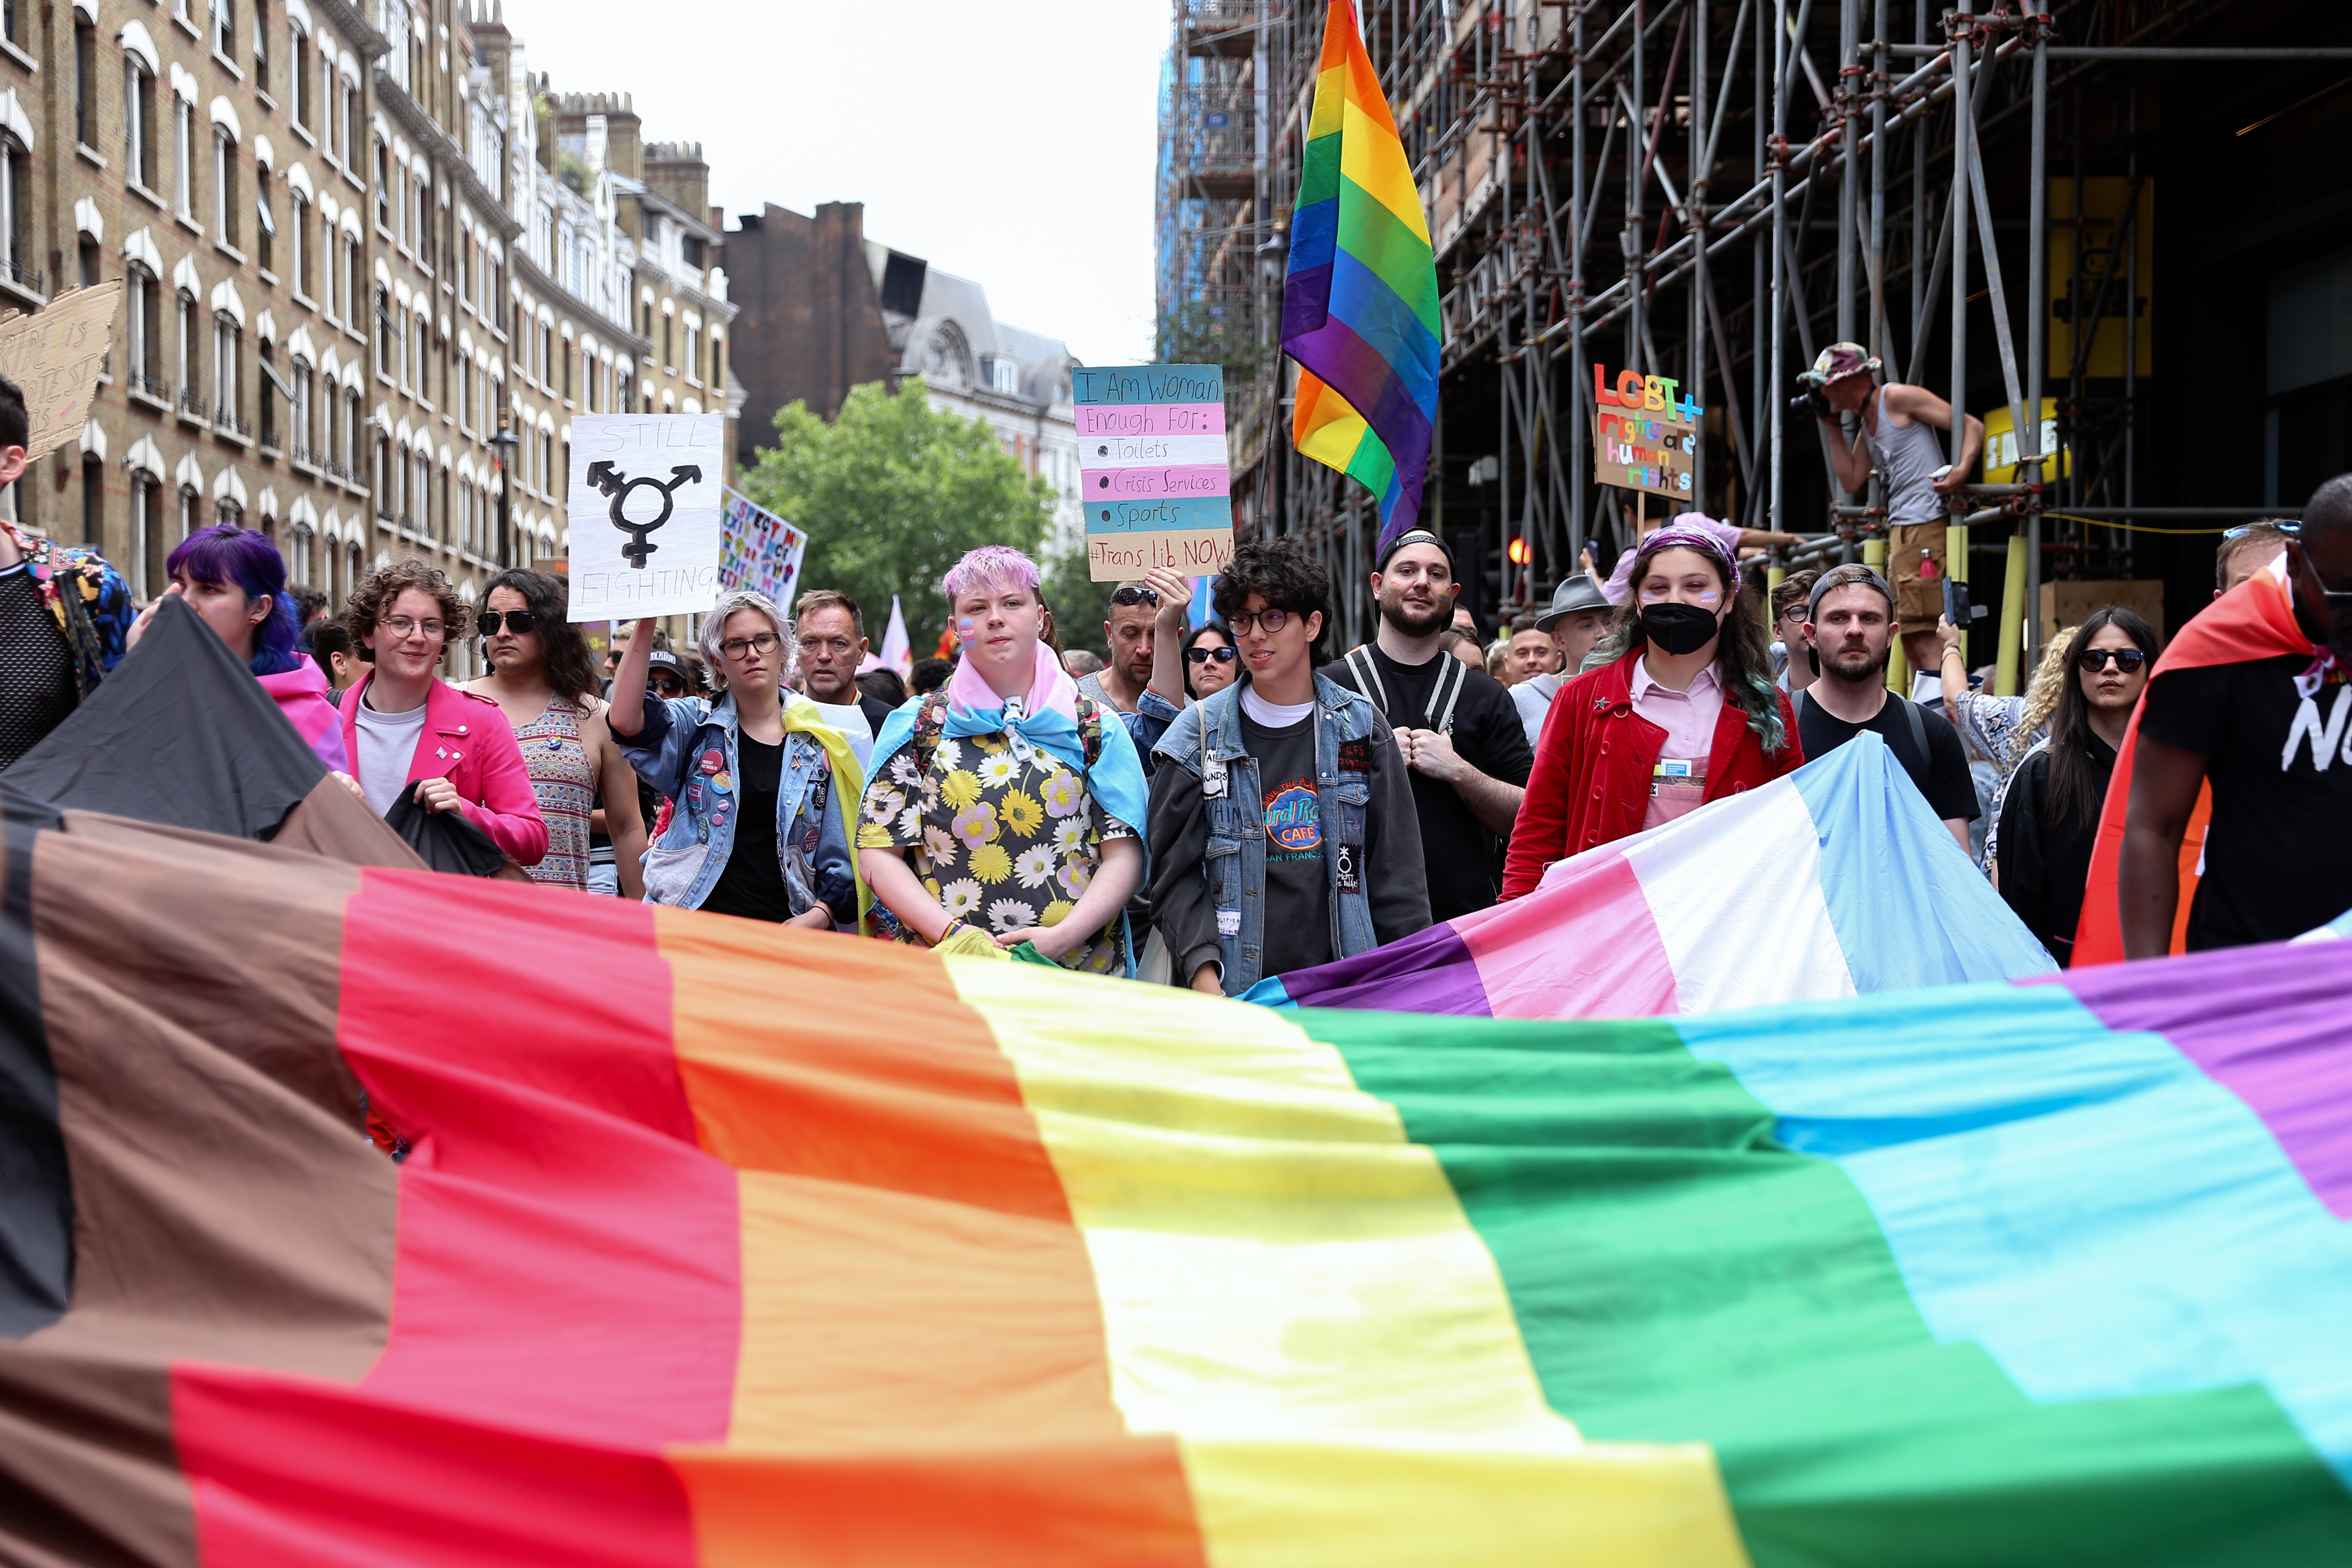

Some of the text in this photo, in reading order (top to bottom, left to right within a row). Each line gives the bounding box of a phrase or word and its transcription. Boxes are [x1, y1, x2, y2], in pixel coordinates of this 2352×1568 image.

[1079, 373, 1098, 402] I
[1594, 363, 1704, 423] LGBT+
[1087, 406, 1154, 435] Enough
[1599, 411, 1696, 456] rights are
[600, 421, 706, 452] STILL
[1110, 438, 1169, 460] Toilets
[1607, 437, 1669, 467] human
[1114, 469, 1217, 493] Crisis Services
[1628, 466, 1692, 492] rights
[1117, 500, 1180, 530] Sports
[784, 530, 802, 552] MY
[1089, 537, 1232, 569] #Trans Lib NOW
[582, 566, 713, 604] FIGHTING
[2281, 683, 2352, 772] N
[1262, 788, 1279, 806] SAVE
[1280, 780, 1295, 790] THE
[1262, 797, 1320, 826] ard Ro
[806, 842, 816, 851] YES
[1281, 827, 1316, 841] CAFE
[1337, 873, 1354, 881] OYCOTT
